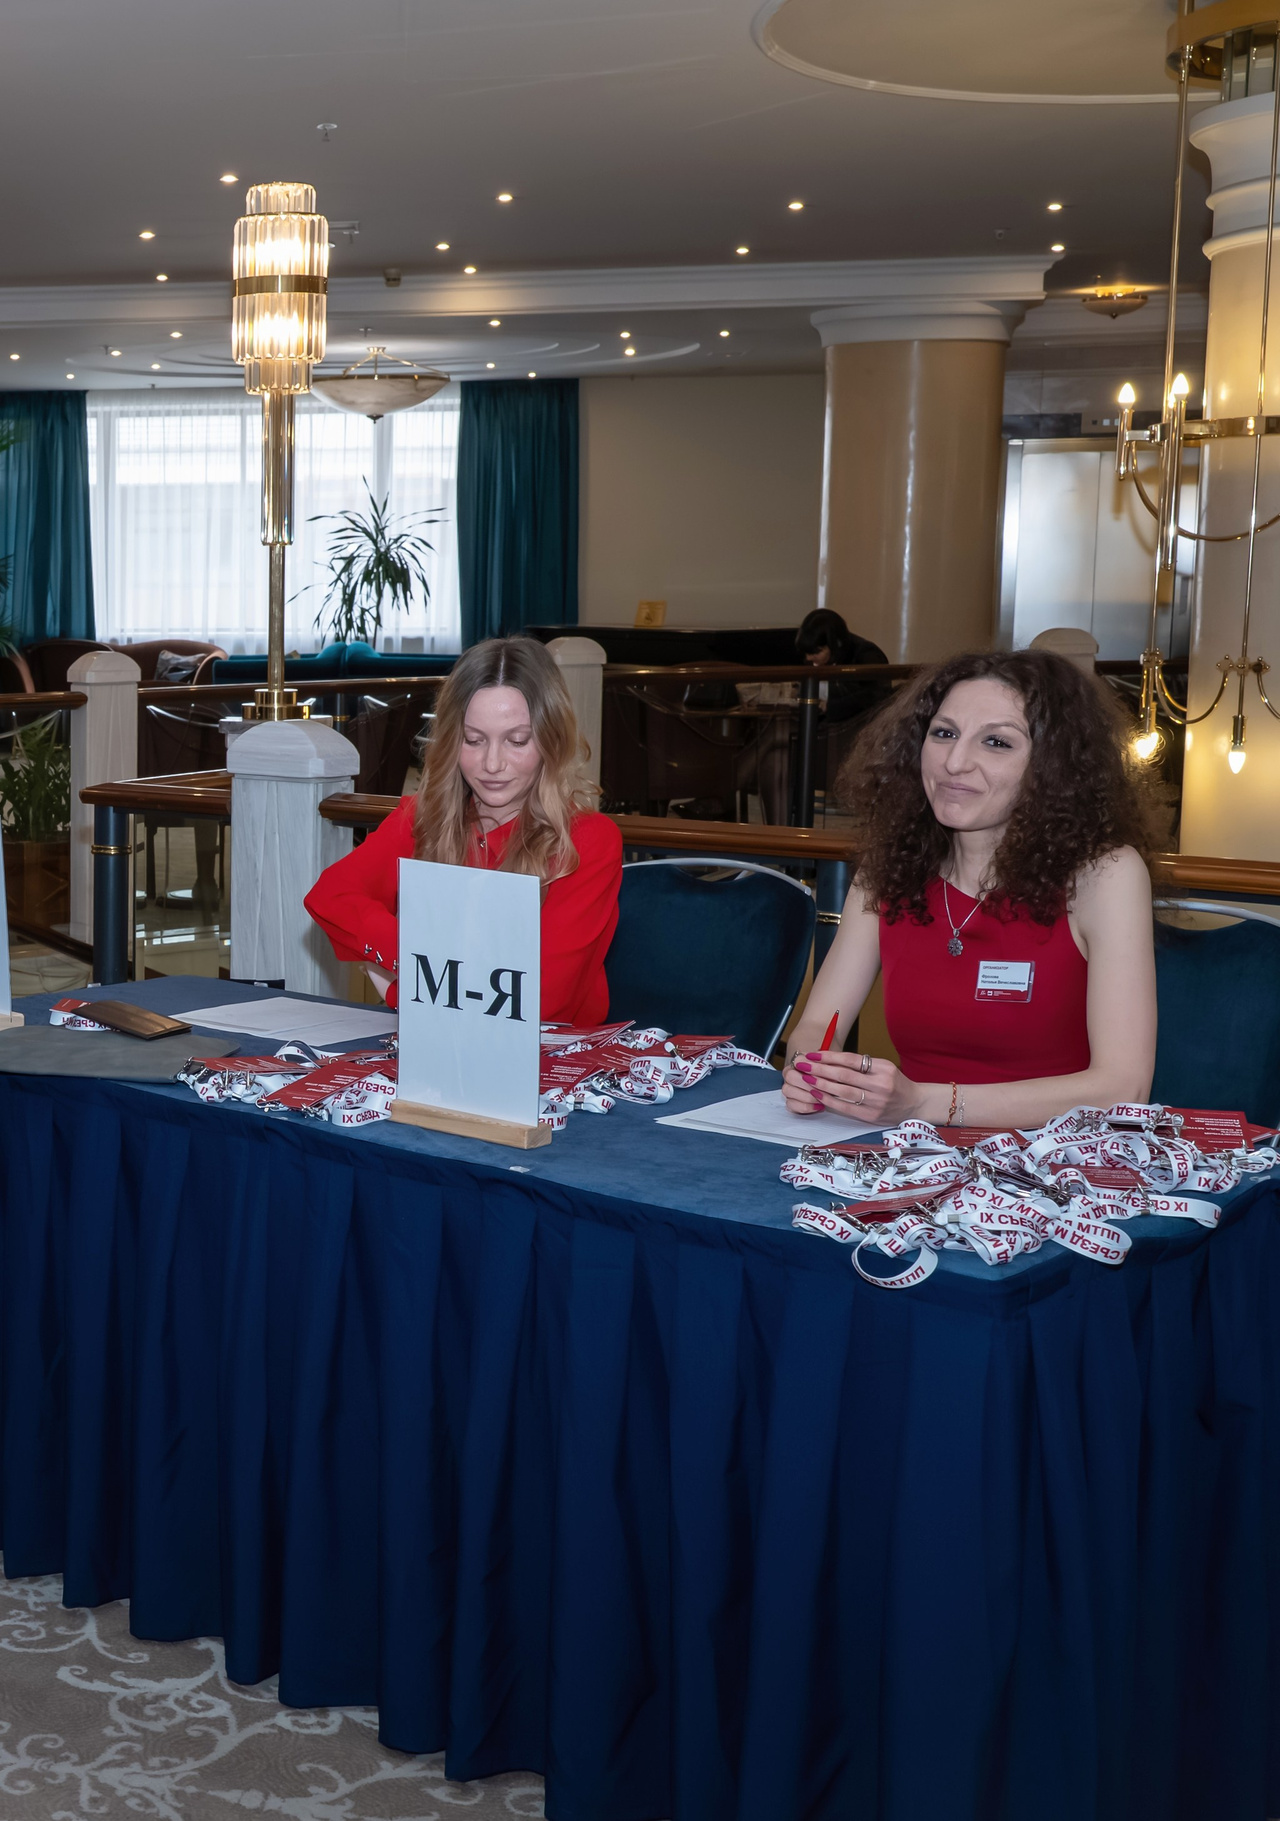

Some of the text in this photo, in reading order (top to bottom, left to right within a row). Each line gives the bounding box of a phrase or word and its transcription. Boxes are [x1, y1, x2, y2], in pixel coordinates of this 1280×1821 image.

[411, 953, 527, 1022] М-Я
[342, 1114, 354, 1124] IX
[1174, 1201, 1188, 1212] IX
[798, 1207, 852, 1240] IX СЪЕЗД
[980, 1212, 995, 1223] IX
[998, 1214, 1040, 1235] СЪЕЗД
[1077, 1222, 1121, 1243] МТПП
[1070, 1231, 1120, 1260] СЪЕЗД
